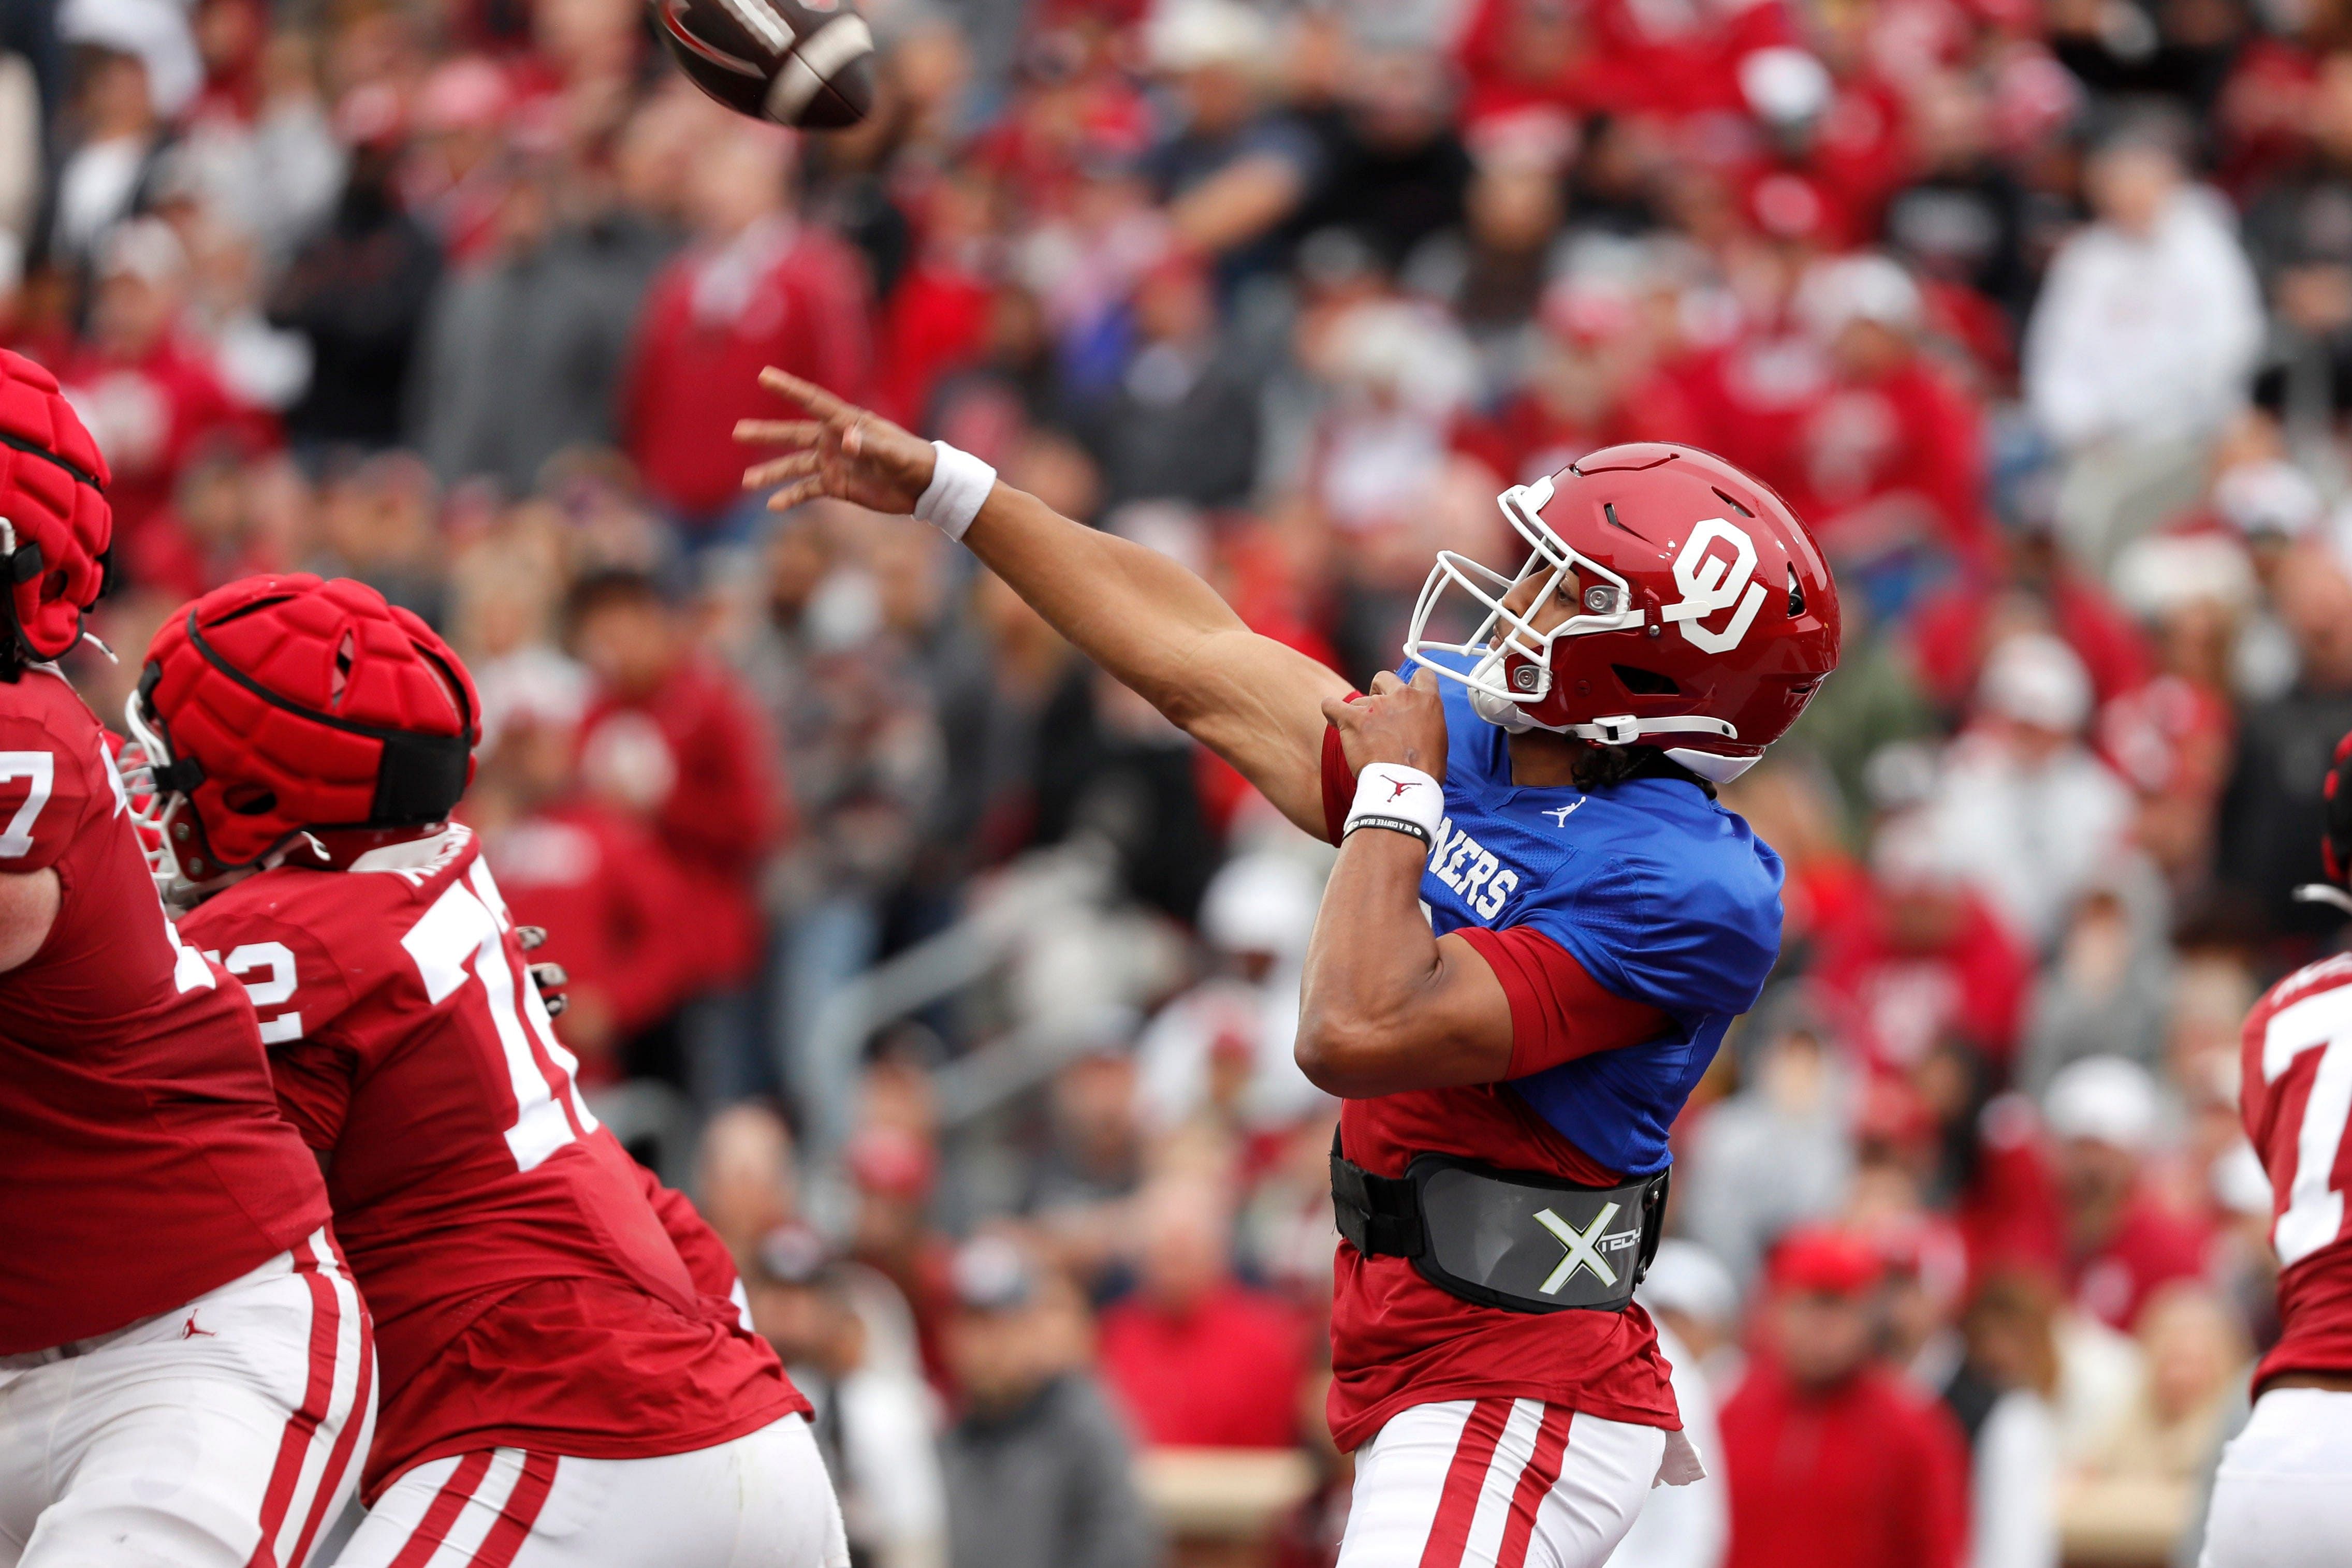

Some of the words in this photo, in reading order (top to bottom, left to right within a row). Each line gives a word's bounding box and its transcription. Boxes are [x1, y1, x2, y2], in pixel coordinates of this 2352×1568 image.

[1376, 818, 1398, 828] COFFEE
[1404, 824, 1413, 832] BE
[1427, 816, 1519, 920] NERS
[202, 942, 303, 1045] 2
